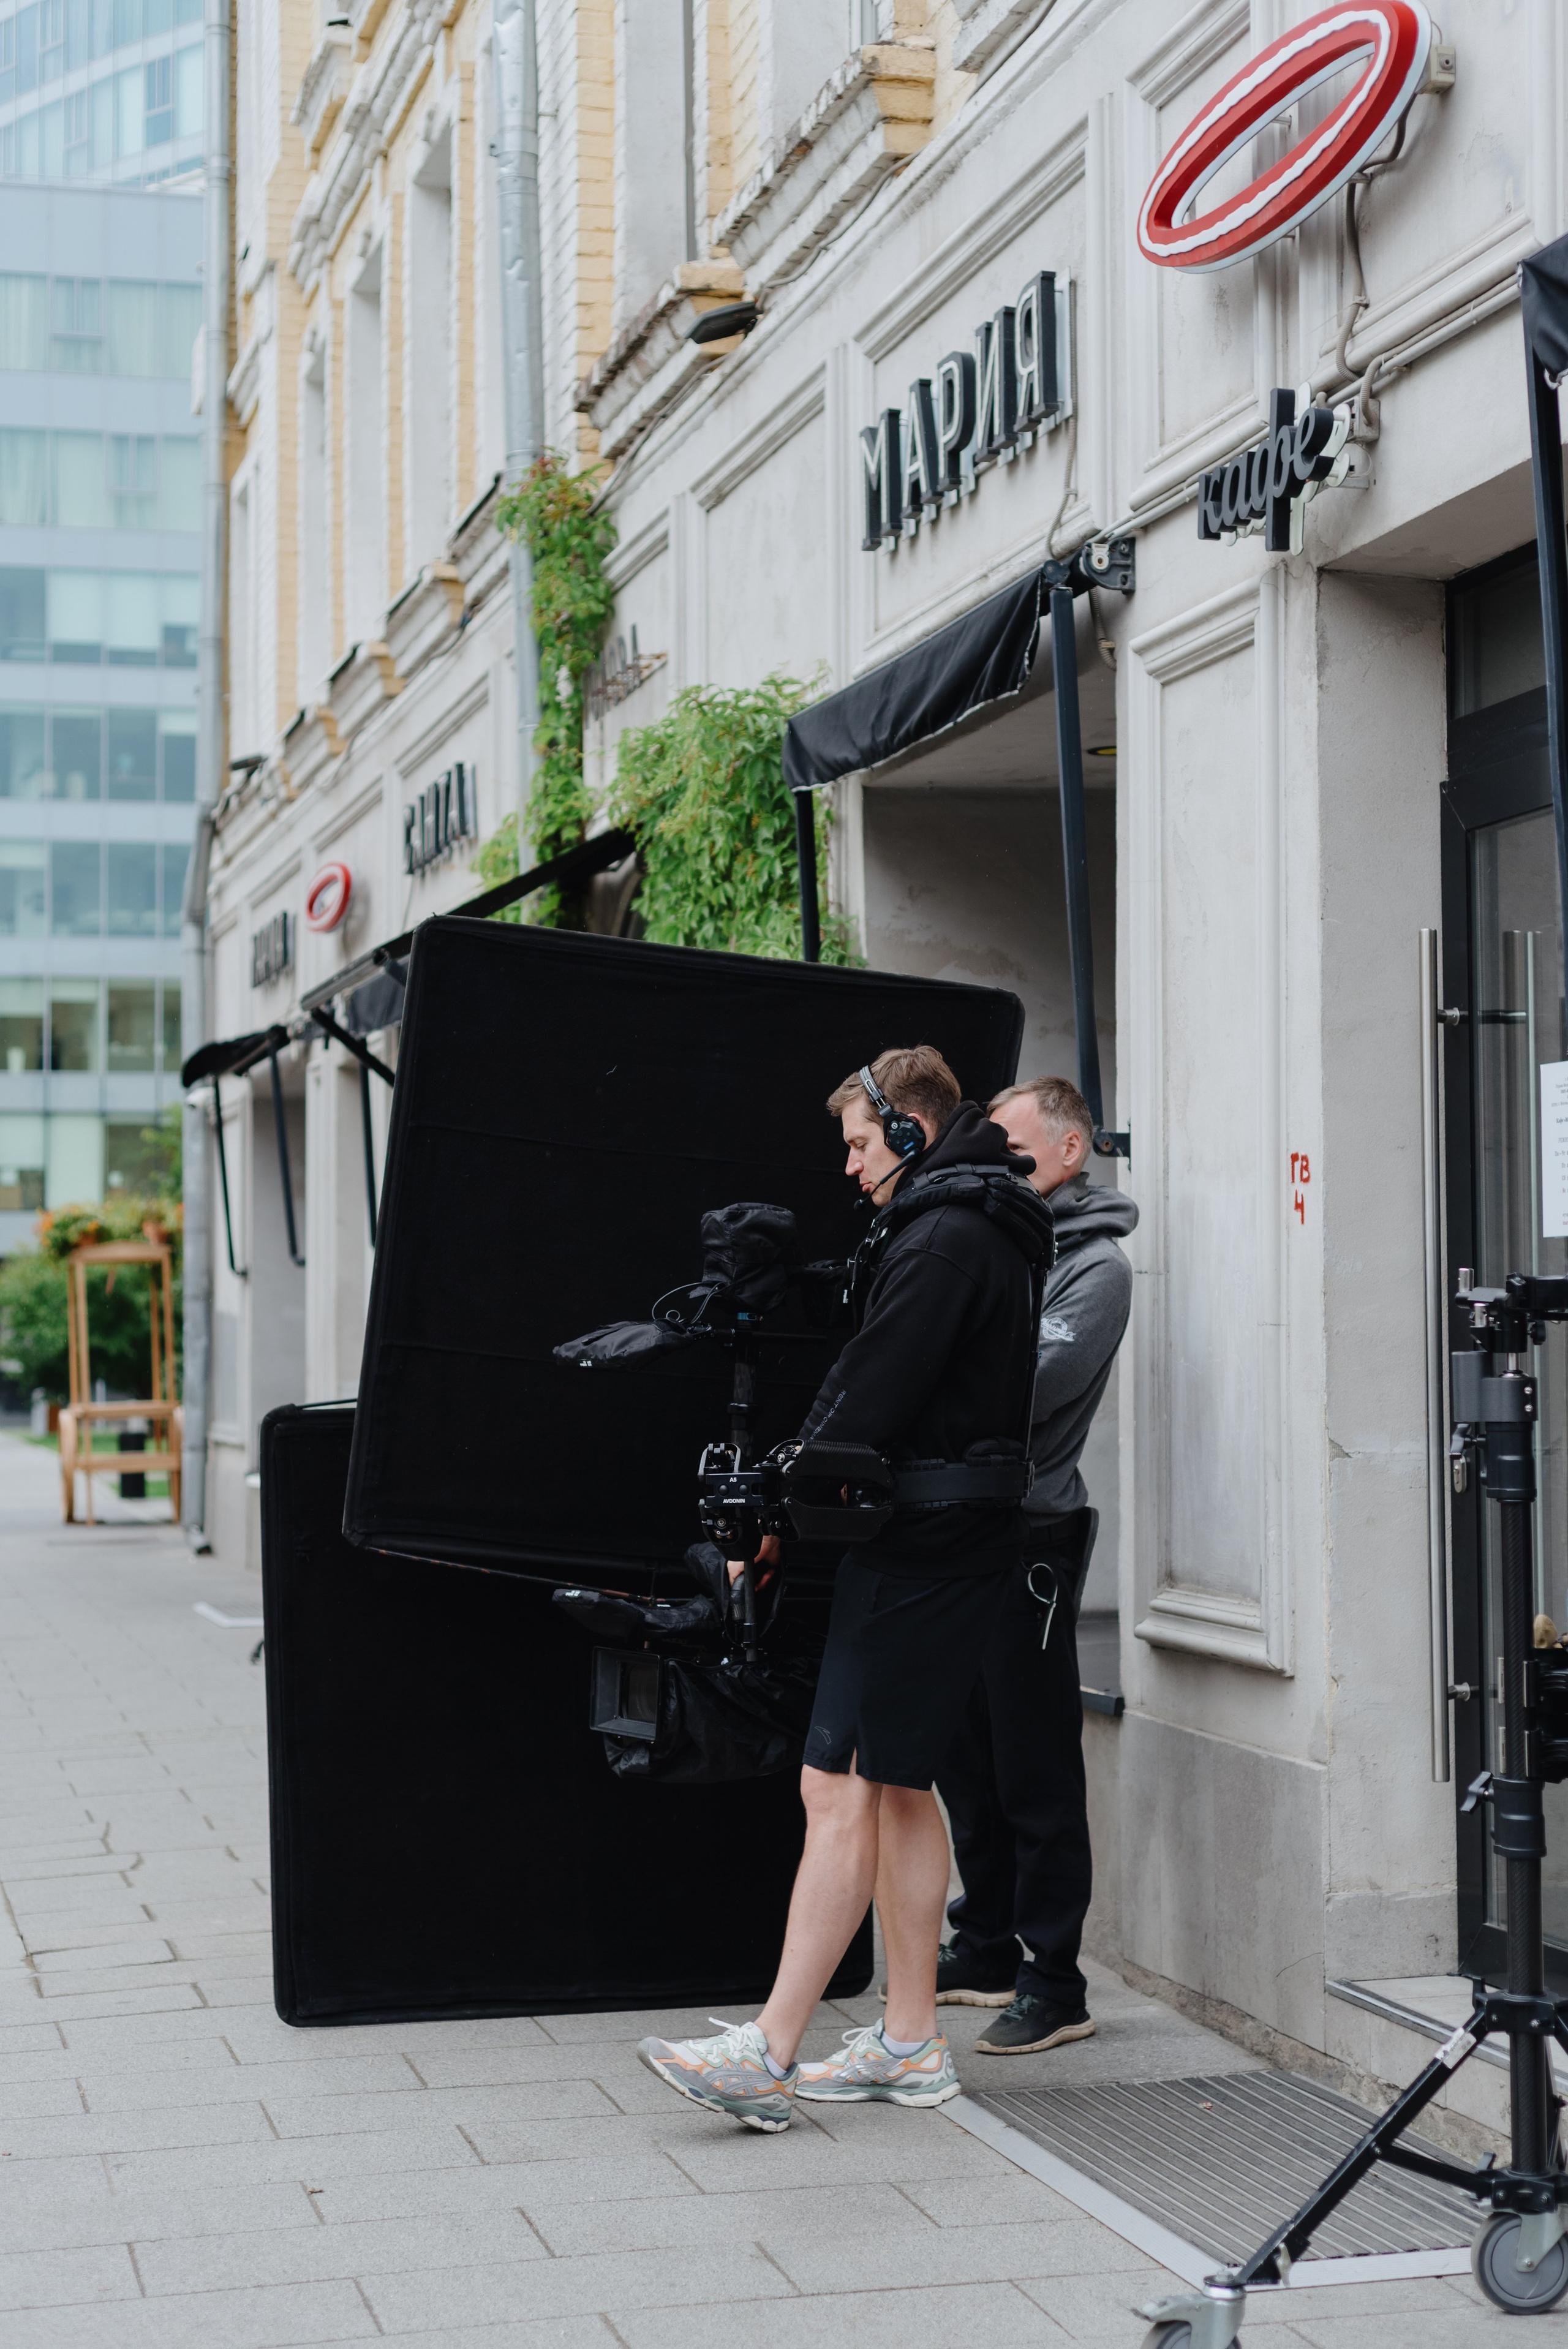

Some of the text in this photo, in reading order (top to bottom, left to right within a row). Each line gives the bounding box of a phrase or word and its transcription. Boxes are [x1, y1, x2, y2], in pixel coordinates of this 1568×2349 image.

[859, 270, 1058, 551] МАРИЯ
[1198, 387, 1335, 551] кафе
[810, 1389, 846, 1440] RENT OF CINEMA
